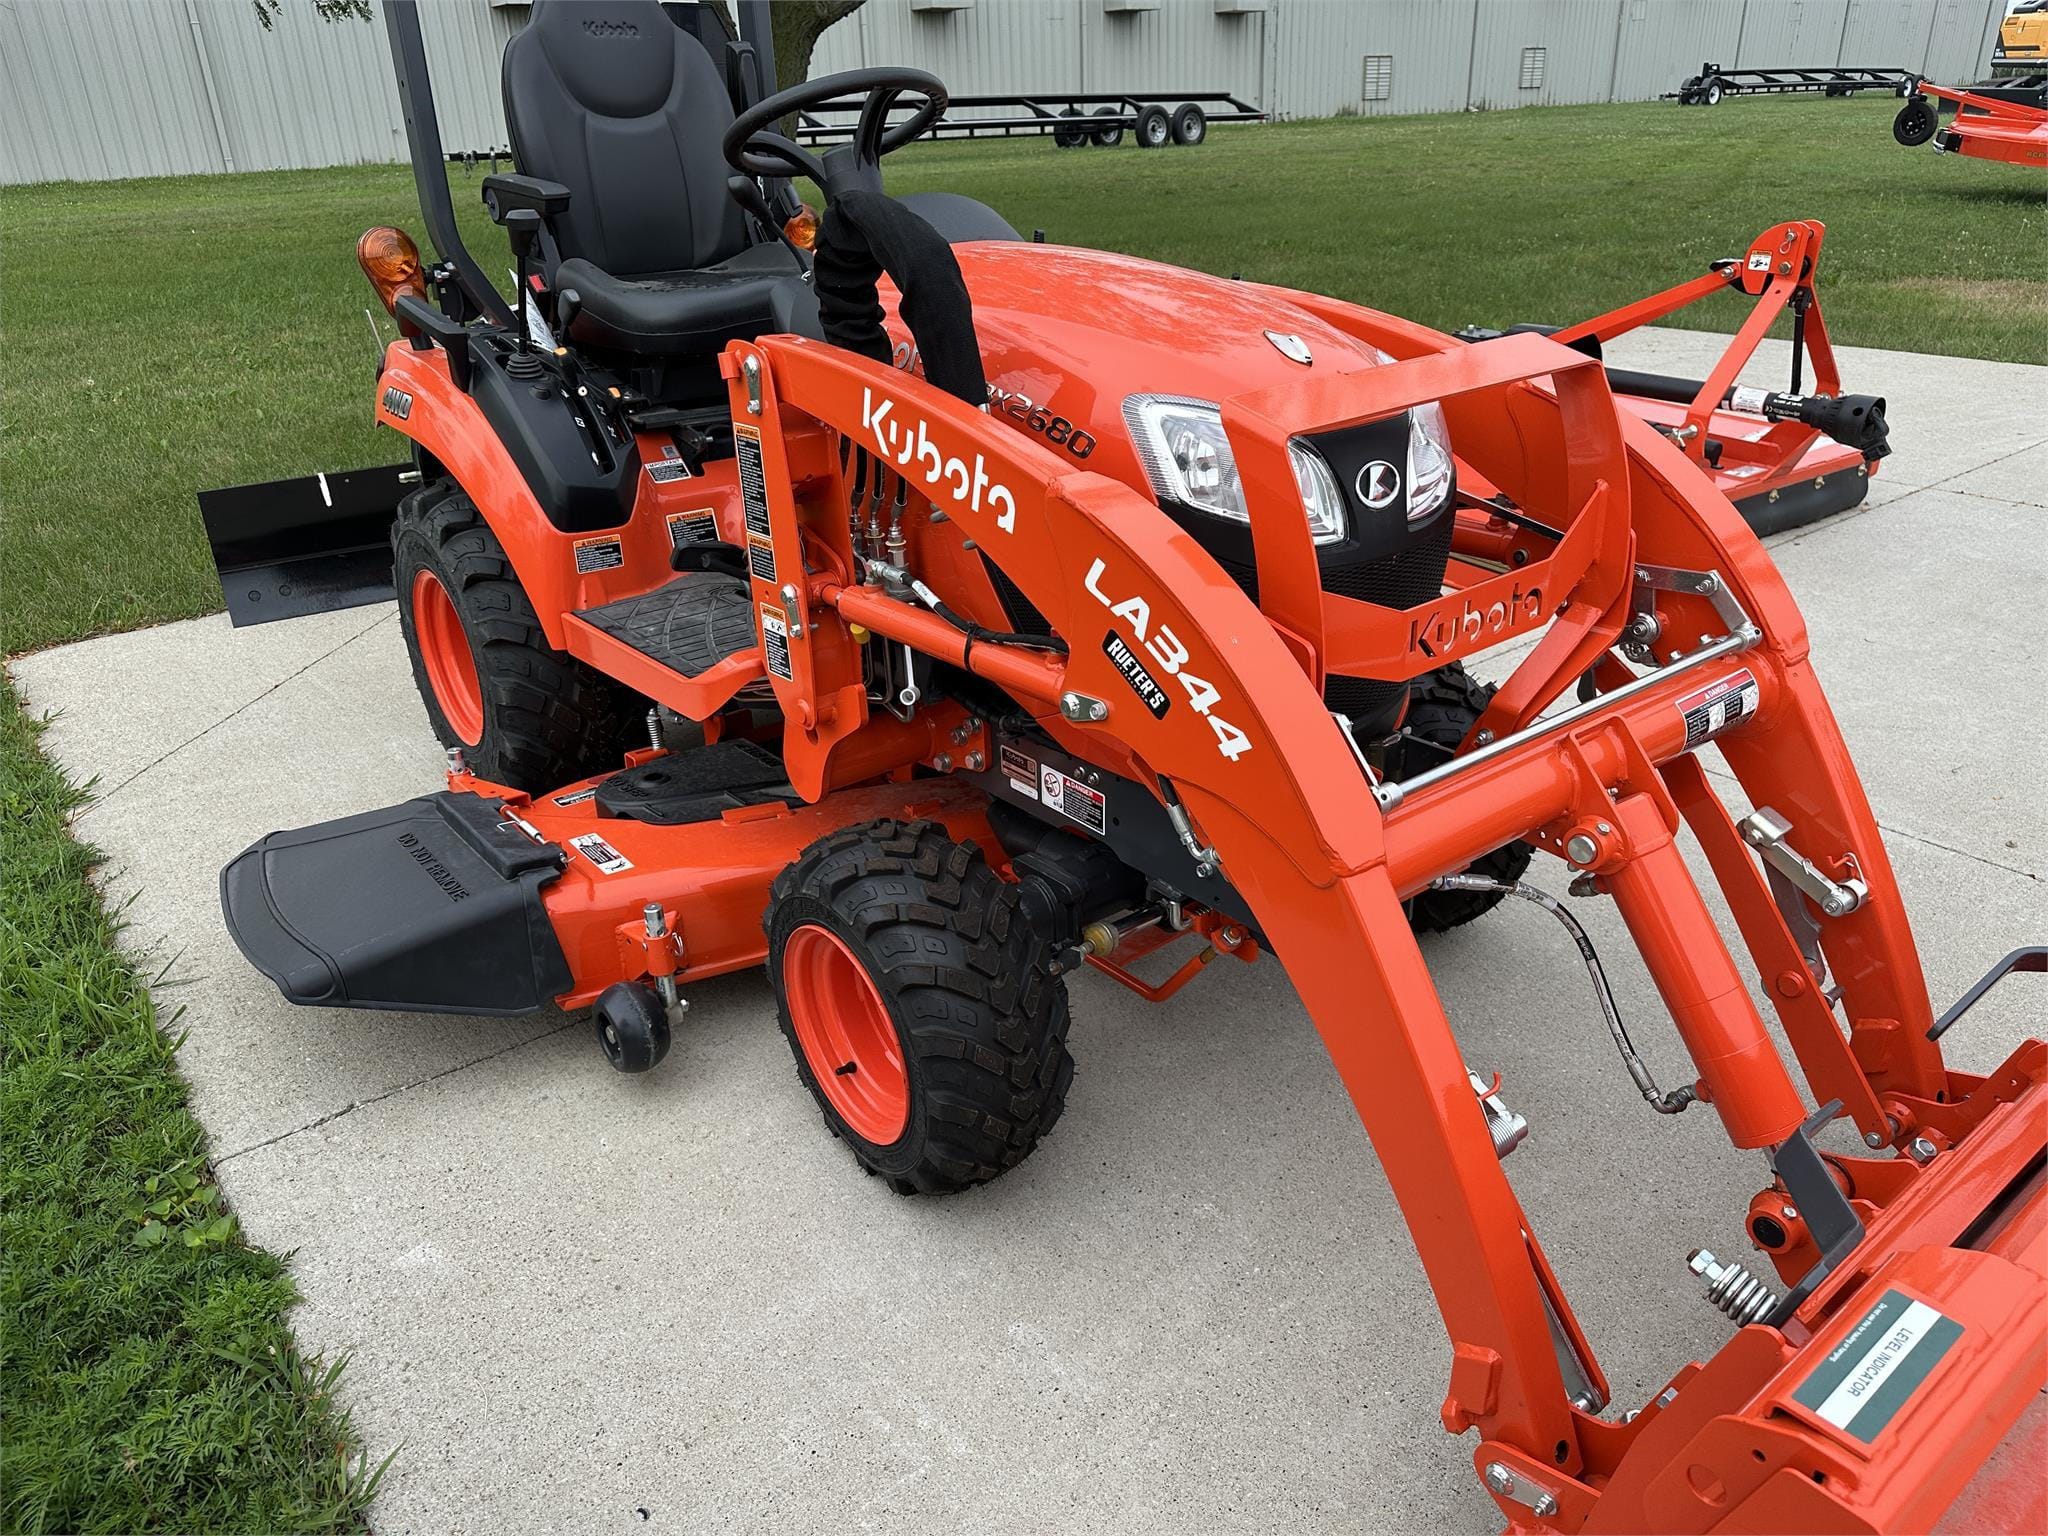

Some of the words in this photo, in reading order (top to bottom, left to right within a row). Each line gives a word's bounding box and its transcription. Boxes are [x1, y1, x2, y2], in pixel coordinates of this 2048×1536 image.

[582, 20, 640, 38] Kubota
[383, 386, 413, 420] 4WD
[862, 387, 1016, 535] Kubota
[1409, 582, 1542, 658] Kubota
[1084, 557, 1253, 762] LA344
[1107, 638, 1165, 709] RUETER'S
[1708, 683, 1729, 698] DANGER
[1071, 780, 1094, 798] DANGER
[397, 832, 418, 848] DO
[409, 846, 437, 866] NOT
[425, 863, 470, 902] REMOVE
[1884, 1327, 1914, 1353] LEVEL
[1847, 1351, 1893, 1397] INDICATOR
